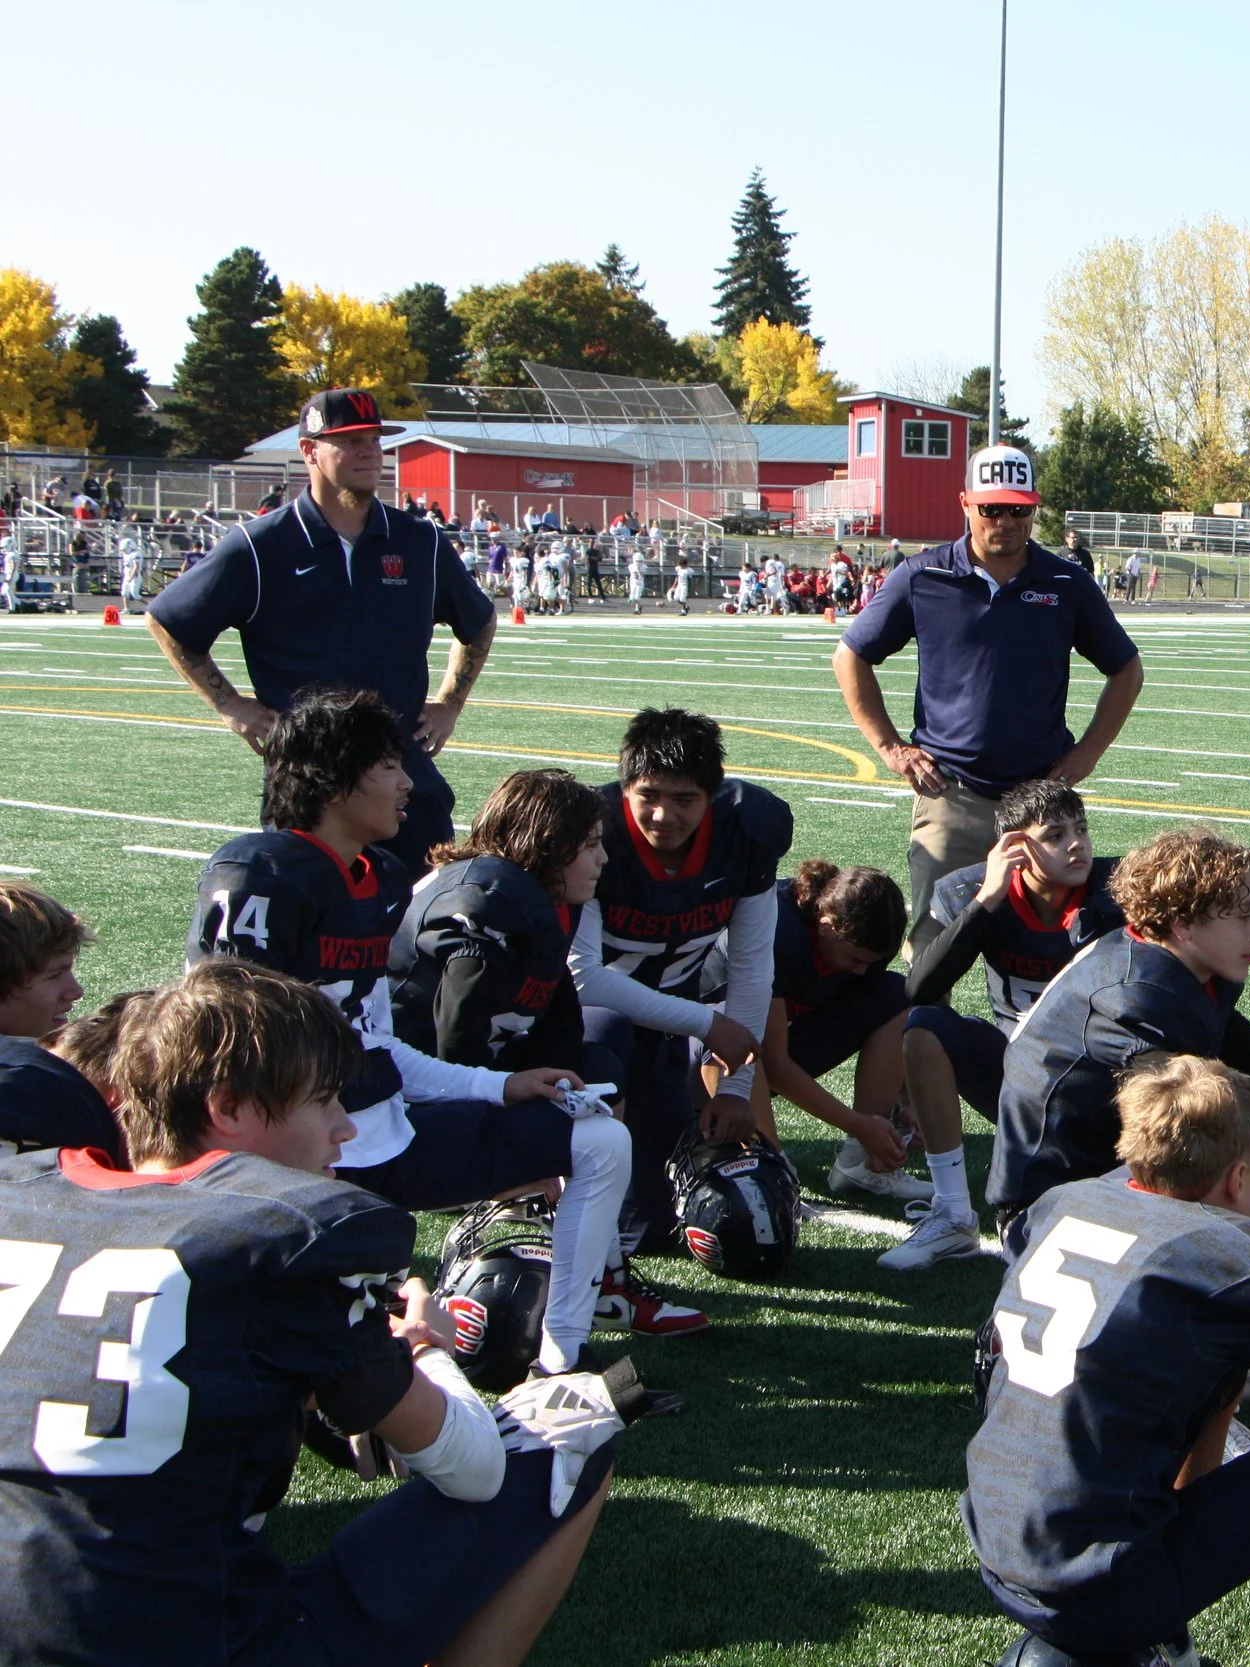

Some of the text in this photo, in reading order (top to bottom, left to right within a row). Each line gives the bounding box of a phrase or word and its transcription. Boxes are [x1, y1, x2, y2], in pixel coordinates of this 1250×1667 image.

[347, 392, 376, 419] W
[979, 460, 1028, 485] CATS
[105, 610, 119, 622] 30
[213, 890, 270, 949] 14
[607, 898, 735, 936] WESTVIEW
[722, 1160, 757, 1174] Riddell
[521, 1247, 553, 1258] iddell
[995, 1216, 1137, 1397] 5
